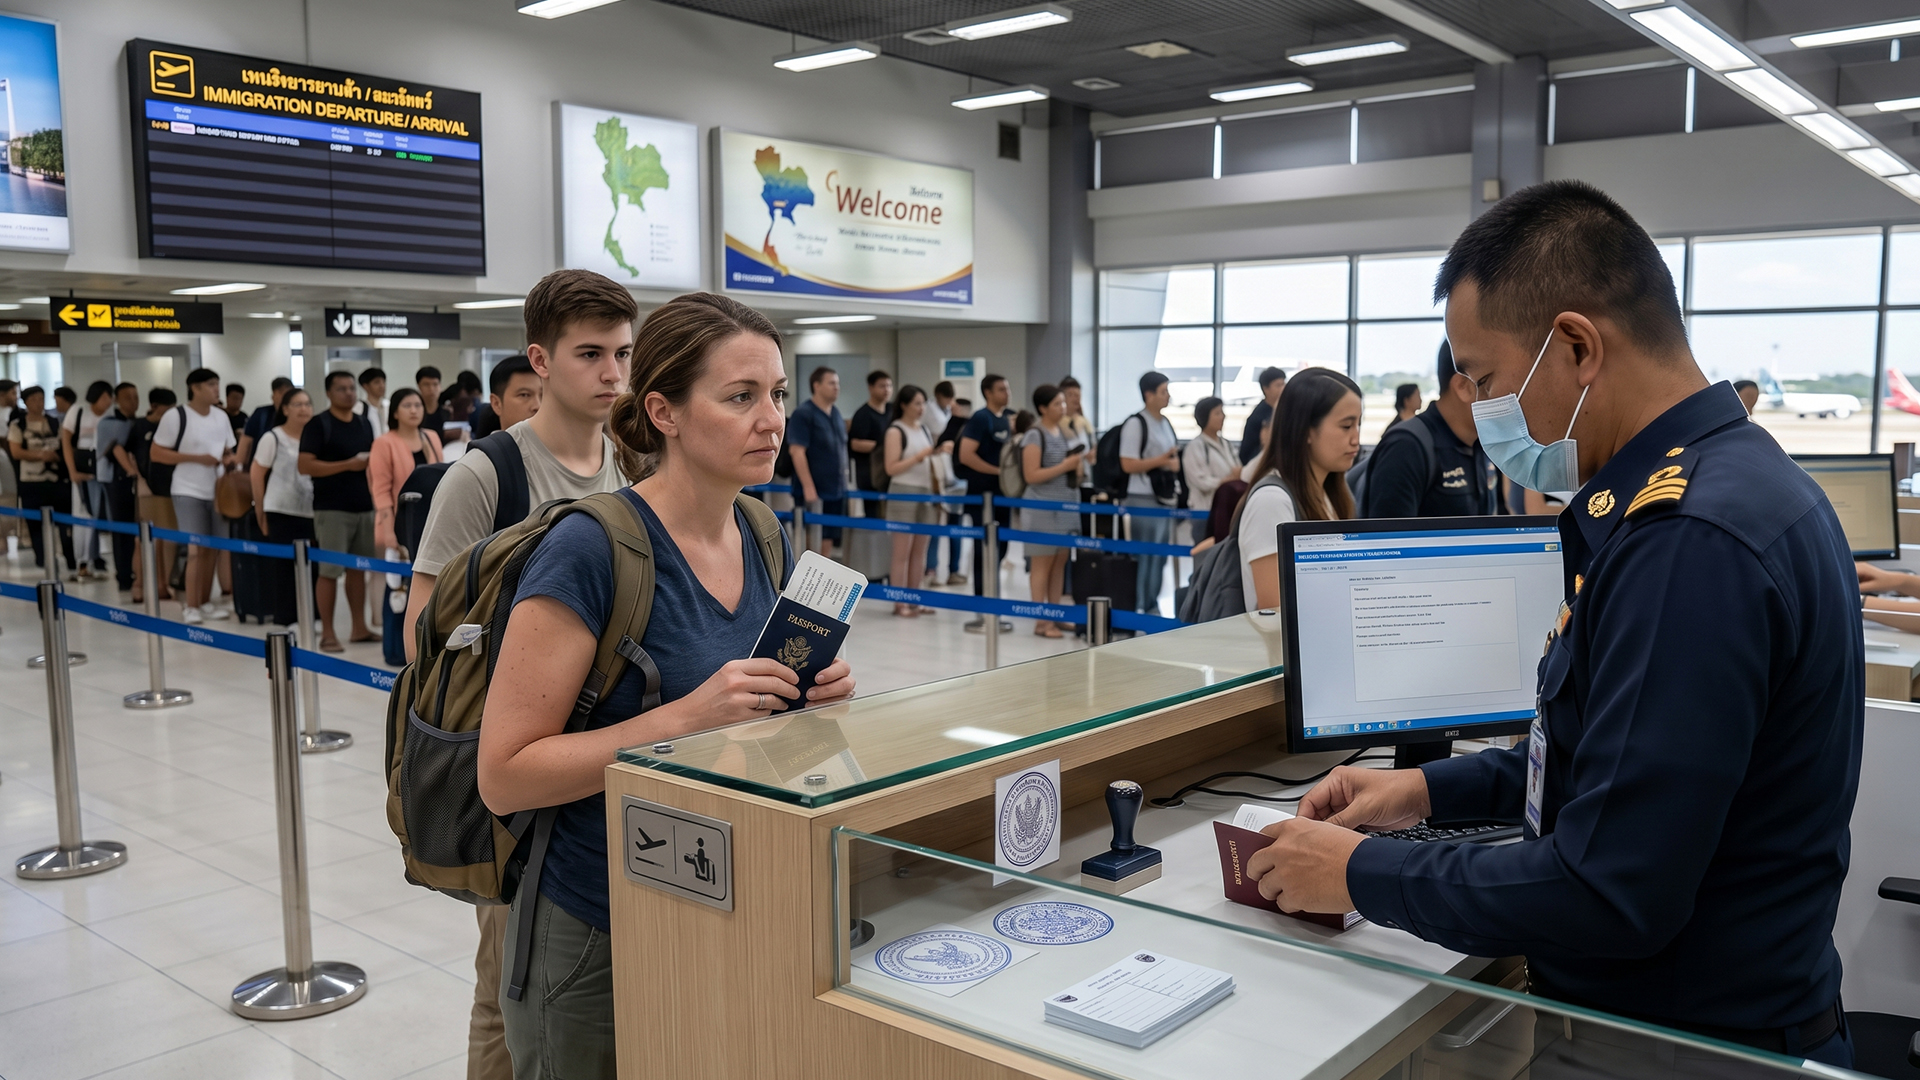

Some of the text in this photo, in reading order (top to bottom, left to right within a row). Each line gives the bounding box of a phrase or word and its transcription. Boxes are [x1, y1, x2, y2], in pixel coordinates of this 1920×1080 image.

[203, 85, 313, 115] IMMIGRATION
[836, 184, 943, 225] Welcome
[787, 613, 832, 637] PASSPORT
